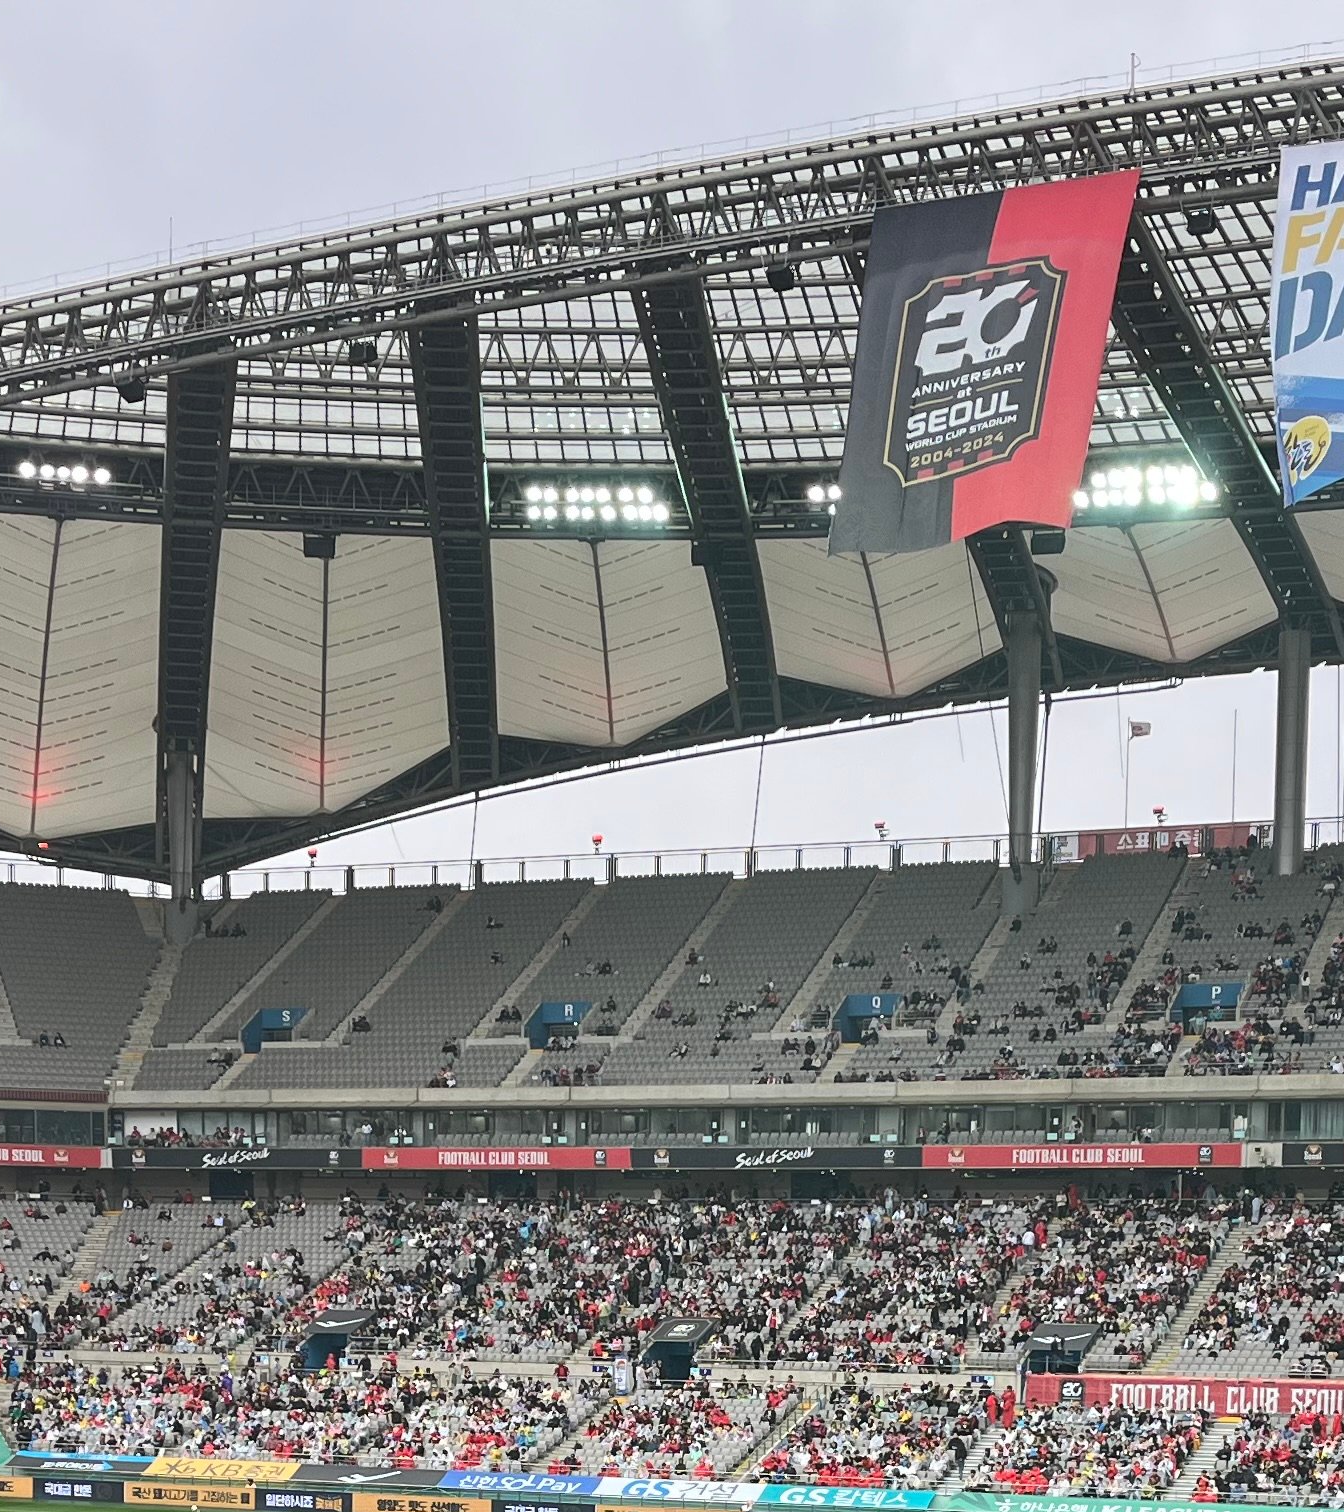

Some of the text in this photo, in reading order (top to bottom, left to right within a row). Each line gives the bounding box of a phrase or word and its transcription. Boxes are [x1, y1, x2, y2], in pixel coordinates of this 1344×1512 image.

[911, 361, 1026, 399] ANNIVERSARY
[956, 386, 973, 399] at
[906, 390, 1019, 440] SEOUL
[905, 415, 1017, 451] WORLD CUP STADIUM
[910, 432, 1004, 468] 2004-2024
[11, 1148, 44, 1162] SEOUL
[237, 1148, 270, 1162] Seoul
[438, 1151, 549, 1165] FOOTBALL CLUB SEOUL
[776, 1147, 814, 1162] Seoul
[1012, 1148, 1144, 1163] FOOTBALL CLUB SEOUL
[1110, 1383, 1215, 1413] FOOTBALL
[1226, 1387, 1281, 1415] CLUB
[44, 1481, 92, 1497] 국대급 한돈
[132, 1487, 150, 1499] 국산
[200, 1489, 237, 1503] 고집하는
[623, 1479, 739, 1501] GS 건설
[266, 1493, 313, 1509] 입단하시죠
[780, 1487, 910, 1509] GS 칼텍스
